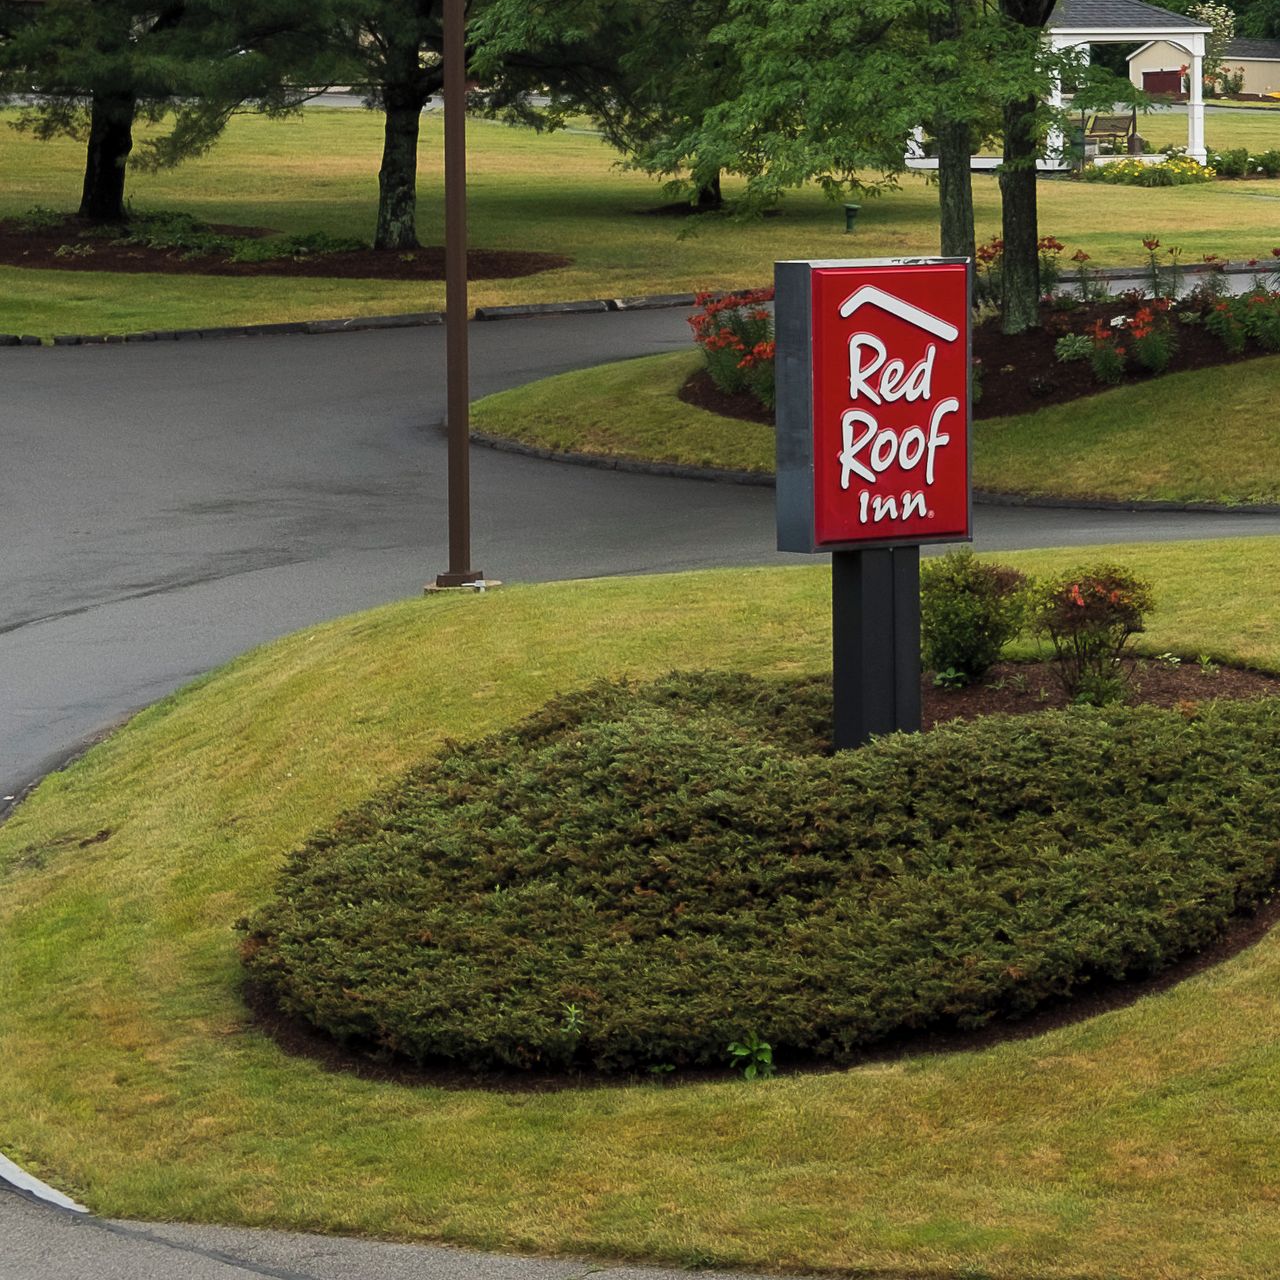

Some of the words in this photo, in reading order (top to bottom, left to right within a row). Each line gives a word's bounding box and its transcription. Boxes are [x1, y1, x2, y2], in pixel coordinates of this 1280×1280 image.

[848, 332, 936, 405] Red
[839, 397, 959, 489] Roof
[859, 490, 928, 523] Inn
